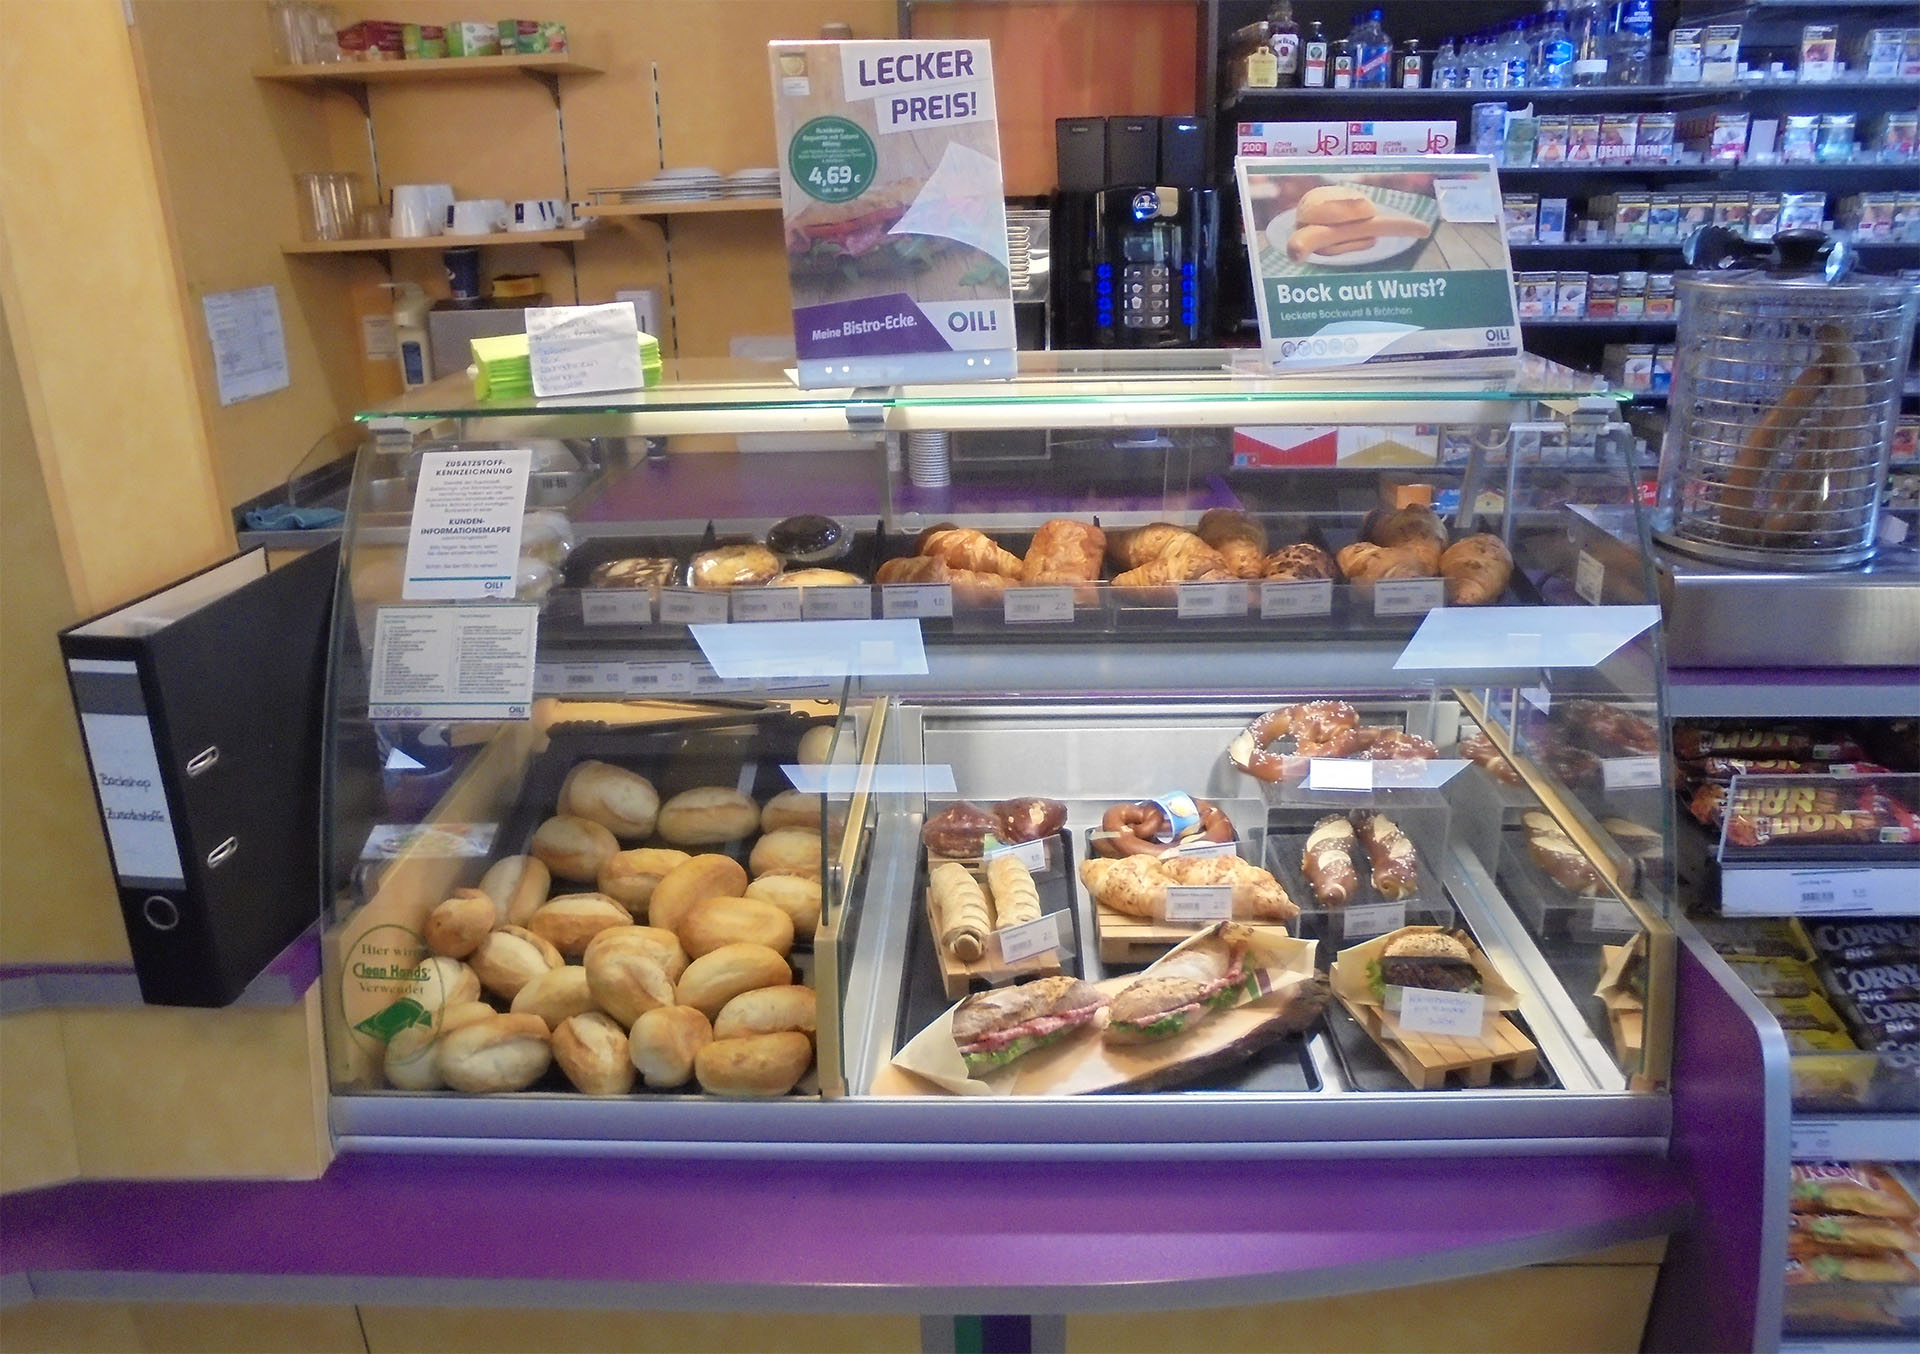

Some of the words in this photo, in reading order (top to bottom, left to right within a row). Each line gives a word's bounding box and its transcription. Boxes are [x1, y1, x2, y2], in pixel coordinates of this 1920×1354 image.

[859, 49, 974, 87] LECKER
[891, 91, 977, 124] PREIS!
[1243, 142, 1263, 152] 200
[1353, 142, 1373, 152] 200
[808, 165, 852, 187] 4,69
[854, 174, 861, 183] €
[1277, 283, 1332, 304] Bock
[1338, 281, 1373, 300] auf
[1377, 278, 1447, 299] Wurst?
[948, 310, 997, 332] OIL!
[1280, 311, 1318, 321] Leckere
[1319, 308, 1363, 319] Bockwurst
[1364, 308, 1372, 316] &
[812, 329, 842, 341] Meine
[842, 313, 918, 336] Bistro-Ecke.
[1485, 328, 1511, 342] OIL!
[445, 459, 506, 468] ZUSATZSTOFF-
[435, 467, 513, 477] KENNZEICHNUNG
[448, 518, 486, 526] KUNDEN-
[420, 526, 512, 536] INFORMATIONSMAPPE
[484, 581, 504, 590] OIL!
[508, 705, 526, 714] OIL!
[1771, 813, 1854, 836] LION
[390, 963, 428, 979] Hands
[1857, 990, 1887, 1002] BIG
[1885, 1018, 1914, 1034] BIG
